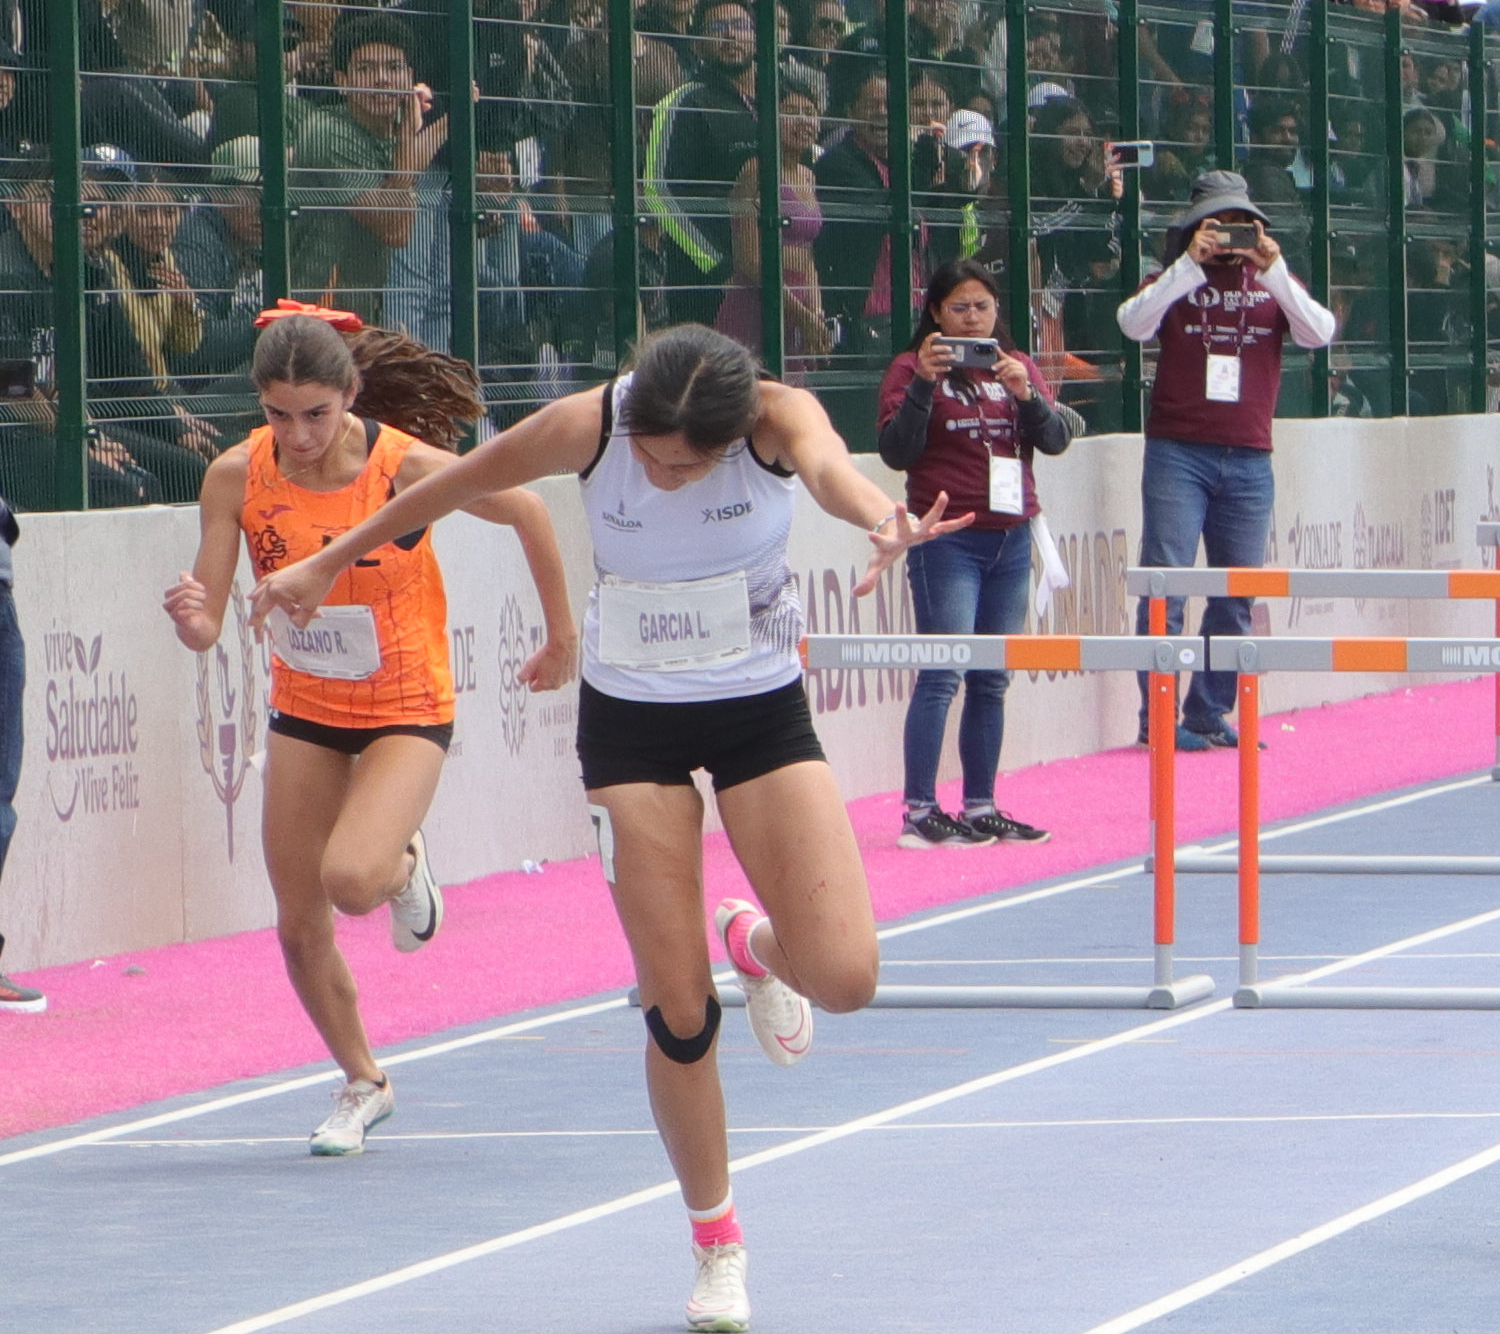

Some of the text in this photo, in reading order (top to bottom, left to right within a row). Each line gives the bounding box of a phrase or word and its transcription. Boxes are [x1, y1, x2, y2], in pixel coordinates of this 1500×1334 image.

[716, 501, 755, 522] ISDE
[286, 629, 348, 655] LOZANO R.
[639, 611, 710, 644] GARCIA L.
[44, 618, 73, 673] vive
[863, 643, 971, 664] MONDO
[46, 670, 138, 762] Saludable
[82, 761, 140, 814] Vive Feliz
